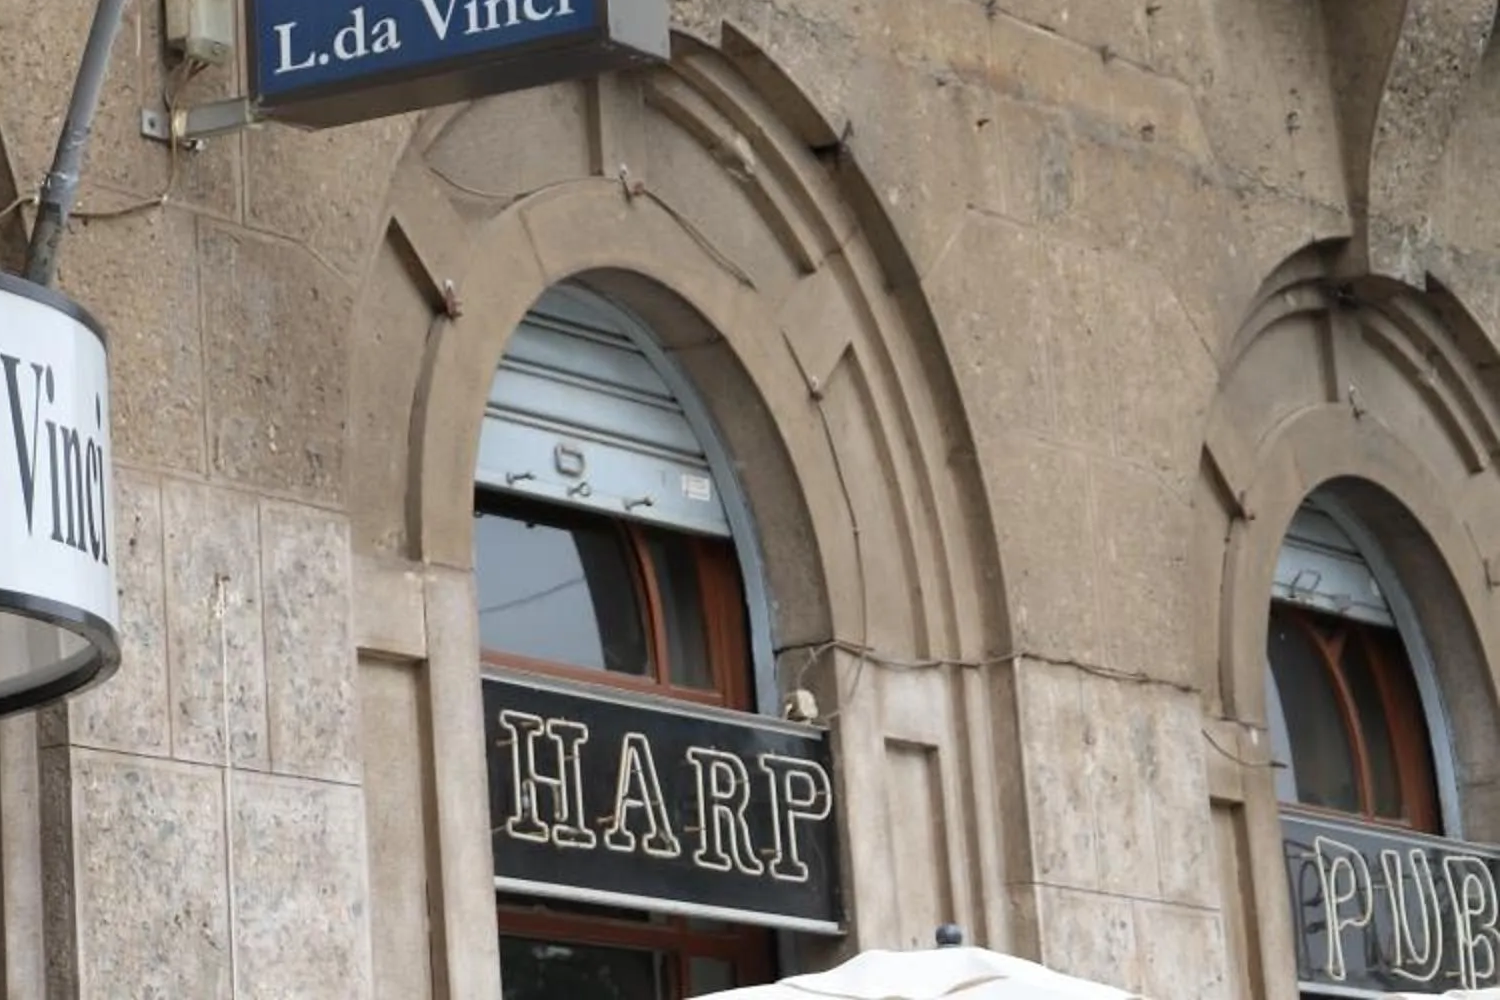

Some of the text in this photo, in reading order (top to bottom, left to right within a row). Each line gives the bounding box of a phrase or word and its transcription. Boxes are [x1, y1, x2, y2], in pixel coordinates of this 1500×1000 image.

[0, 353, 109, 566] Vinci
[500, 710, 832, 881] HARP
[1315, 835, 1500, 989] PUB
